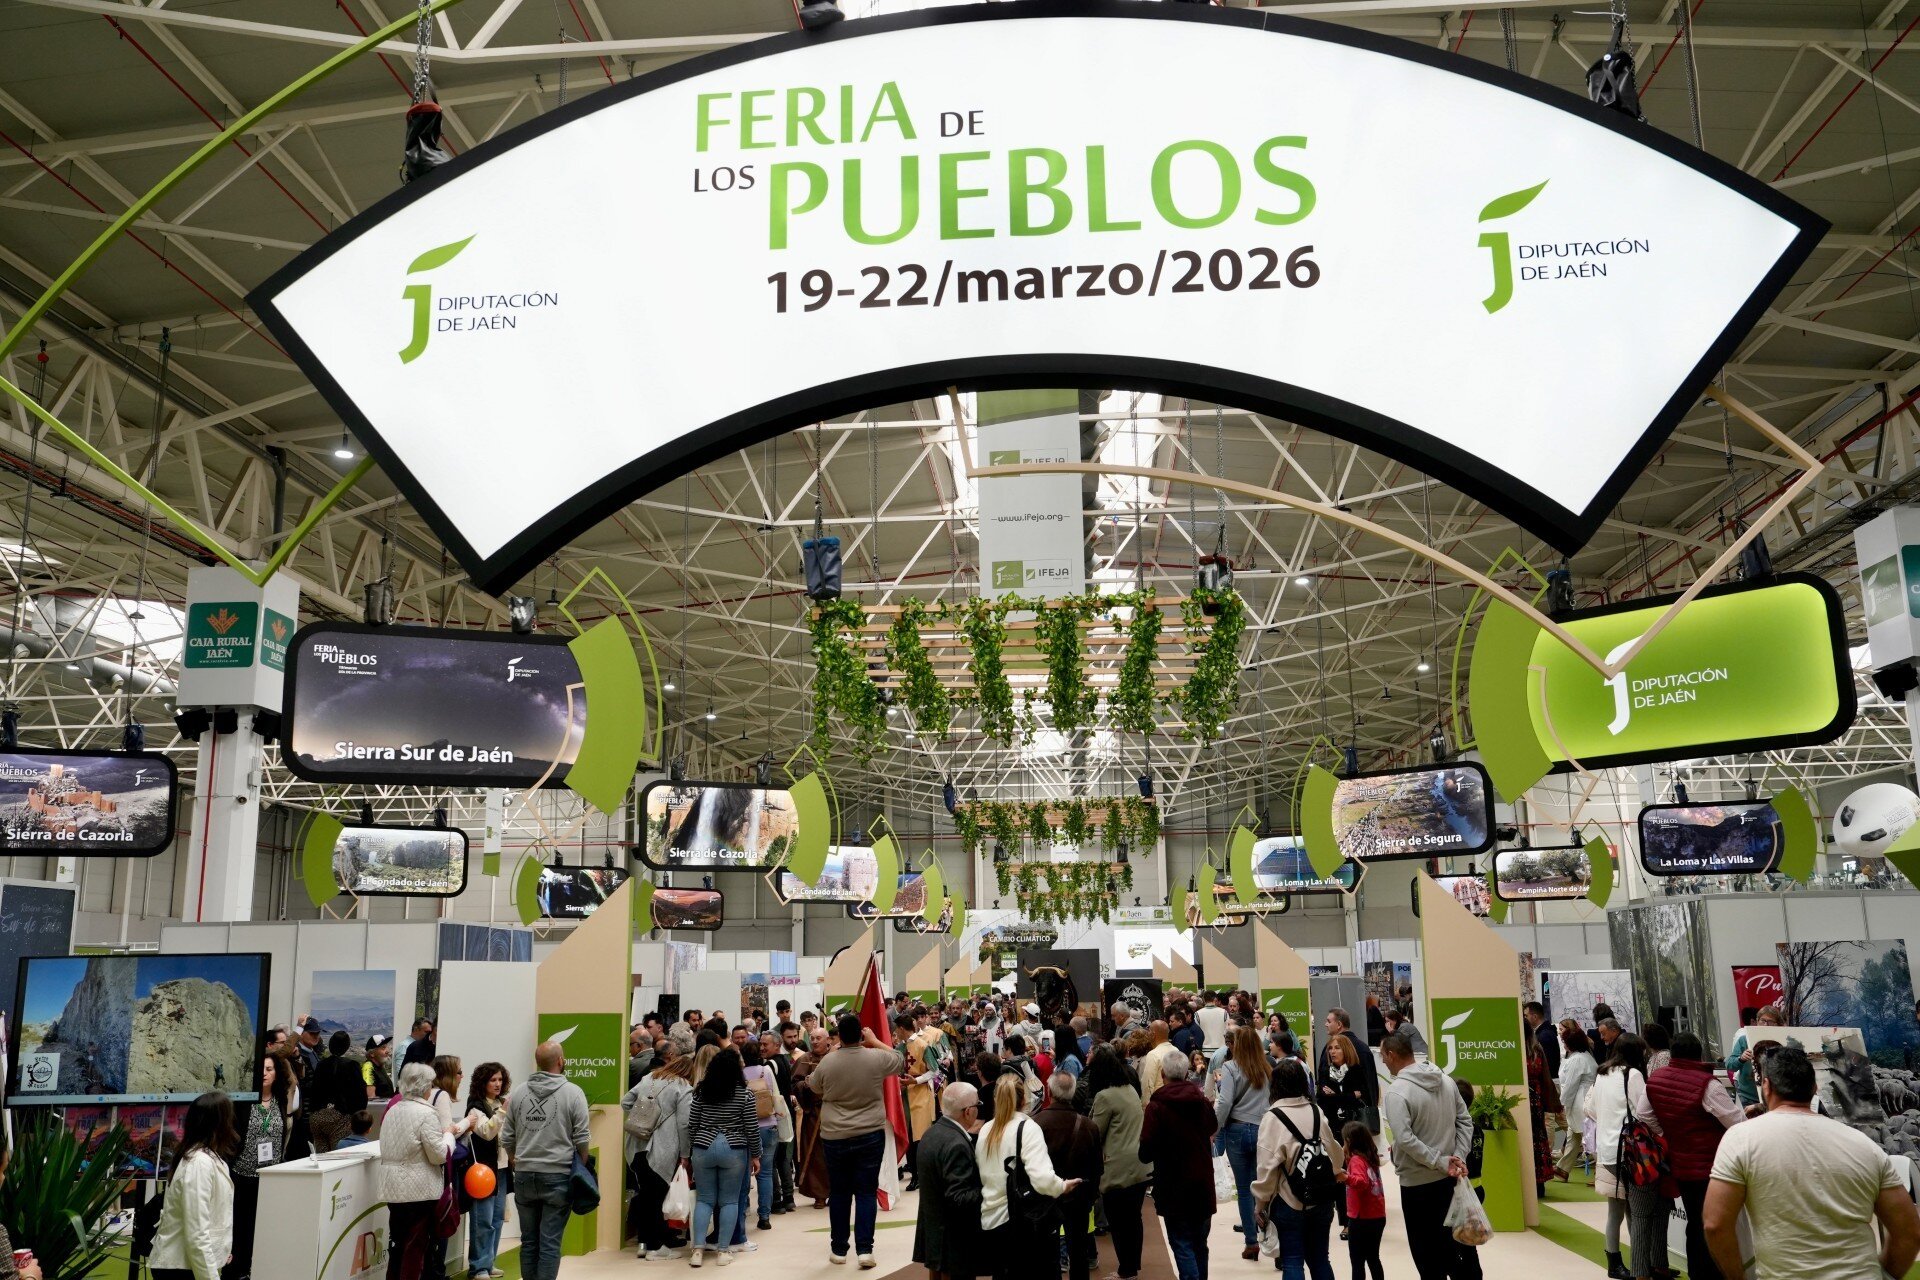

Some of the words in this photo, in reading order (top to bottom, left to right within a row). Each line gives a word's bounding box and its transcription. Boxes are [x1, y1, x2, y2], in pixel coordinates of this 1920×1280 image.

[695, 81, 917, 153] FERIA
[940, 109, 985, 137] DE
[693, 165, 756, 193] LOS
[768, 135, 1317, 250] PUEBLOS
[1518, 238, 1650, 259] DIPUTACIÓN
[1520, 265, 1550, 281] DE
[1554, 261, 1607, 280] JAÉN
[766, 245, 1322, 314] 19-22/marzo/2026
[438, 290, 559, 311] DIPUTACIÓN
[437, 317, 464, 332] DE
[467, 314, 516, 331] JAÉN
[1038, 567, 1069, 577] IFEJA
[189, 637, 215, 648] CAJA
[216, 637, 252, 647] RURAL
[313, 644, 339, 653] FERIA
[206, 647, 232, 659] JAÉN
[321, 652, 378, 665] PUEBLOS
[1632, 668, 1728, 693] DIPUTACIÓN
[1634, 694, 1656, 709] DE
[1658, 689, 1697, 706] JAÉN
[334, 741, 395, 760] Sierra
[400, 743, 435, 761] Sur
[439, 744, 465, 762] de
[468, 746, 514, 763] Jaén
[6, 828, 51, 840] Sierra
[55, 829, 75, 841] de
[78, 829, 133, 842] Cazorla
[1375, 837, 1406, 849] Sierra
[1408, 836, 1422, 846] de
[1423, 834, 1462, 846] Segura
[669, 847, 700, 858] Sierra
[703, 848, 717, 858] de
[718, 848, 758, 859] Cazorla
[1660, 858, 1671, 867] La
[1673, 857, 1700, 866] Loma
[1702, 859, 1708, 867] y
[1709, 856, 1726, 865] Las
[1726, 855, 1754, 864] Villas
[371, 878, 415, 887] Condado
[415, 879, 426, 887] de
[427, 879, 448, 887] Jaén
[1275, 879, 1283, 887] La
[800, 887, 831, 896] Condado
[832, 888, 840, 896] de
[1517, 886, 1547, 895] Campiña
[1016, 935, 1050, 943] CLIMÁTICO
[1458, 1039, 1516, 1049] DIPUTACIÓN
[1459, 1051, 1472, 1060] DE
[1473, 1050, 1497, 1060] JAÉN
[573, 1067, 597, 1078] JAÉN
